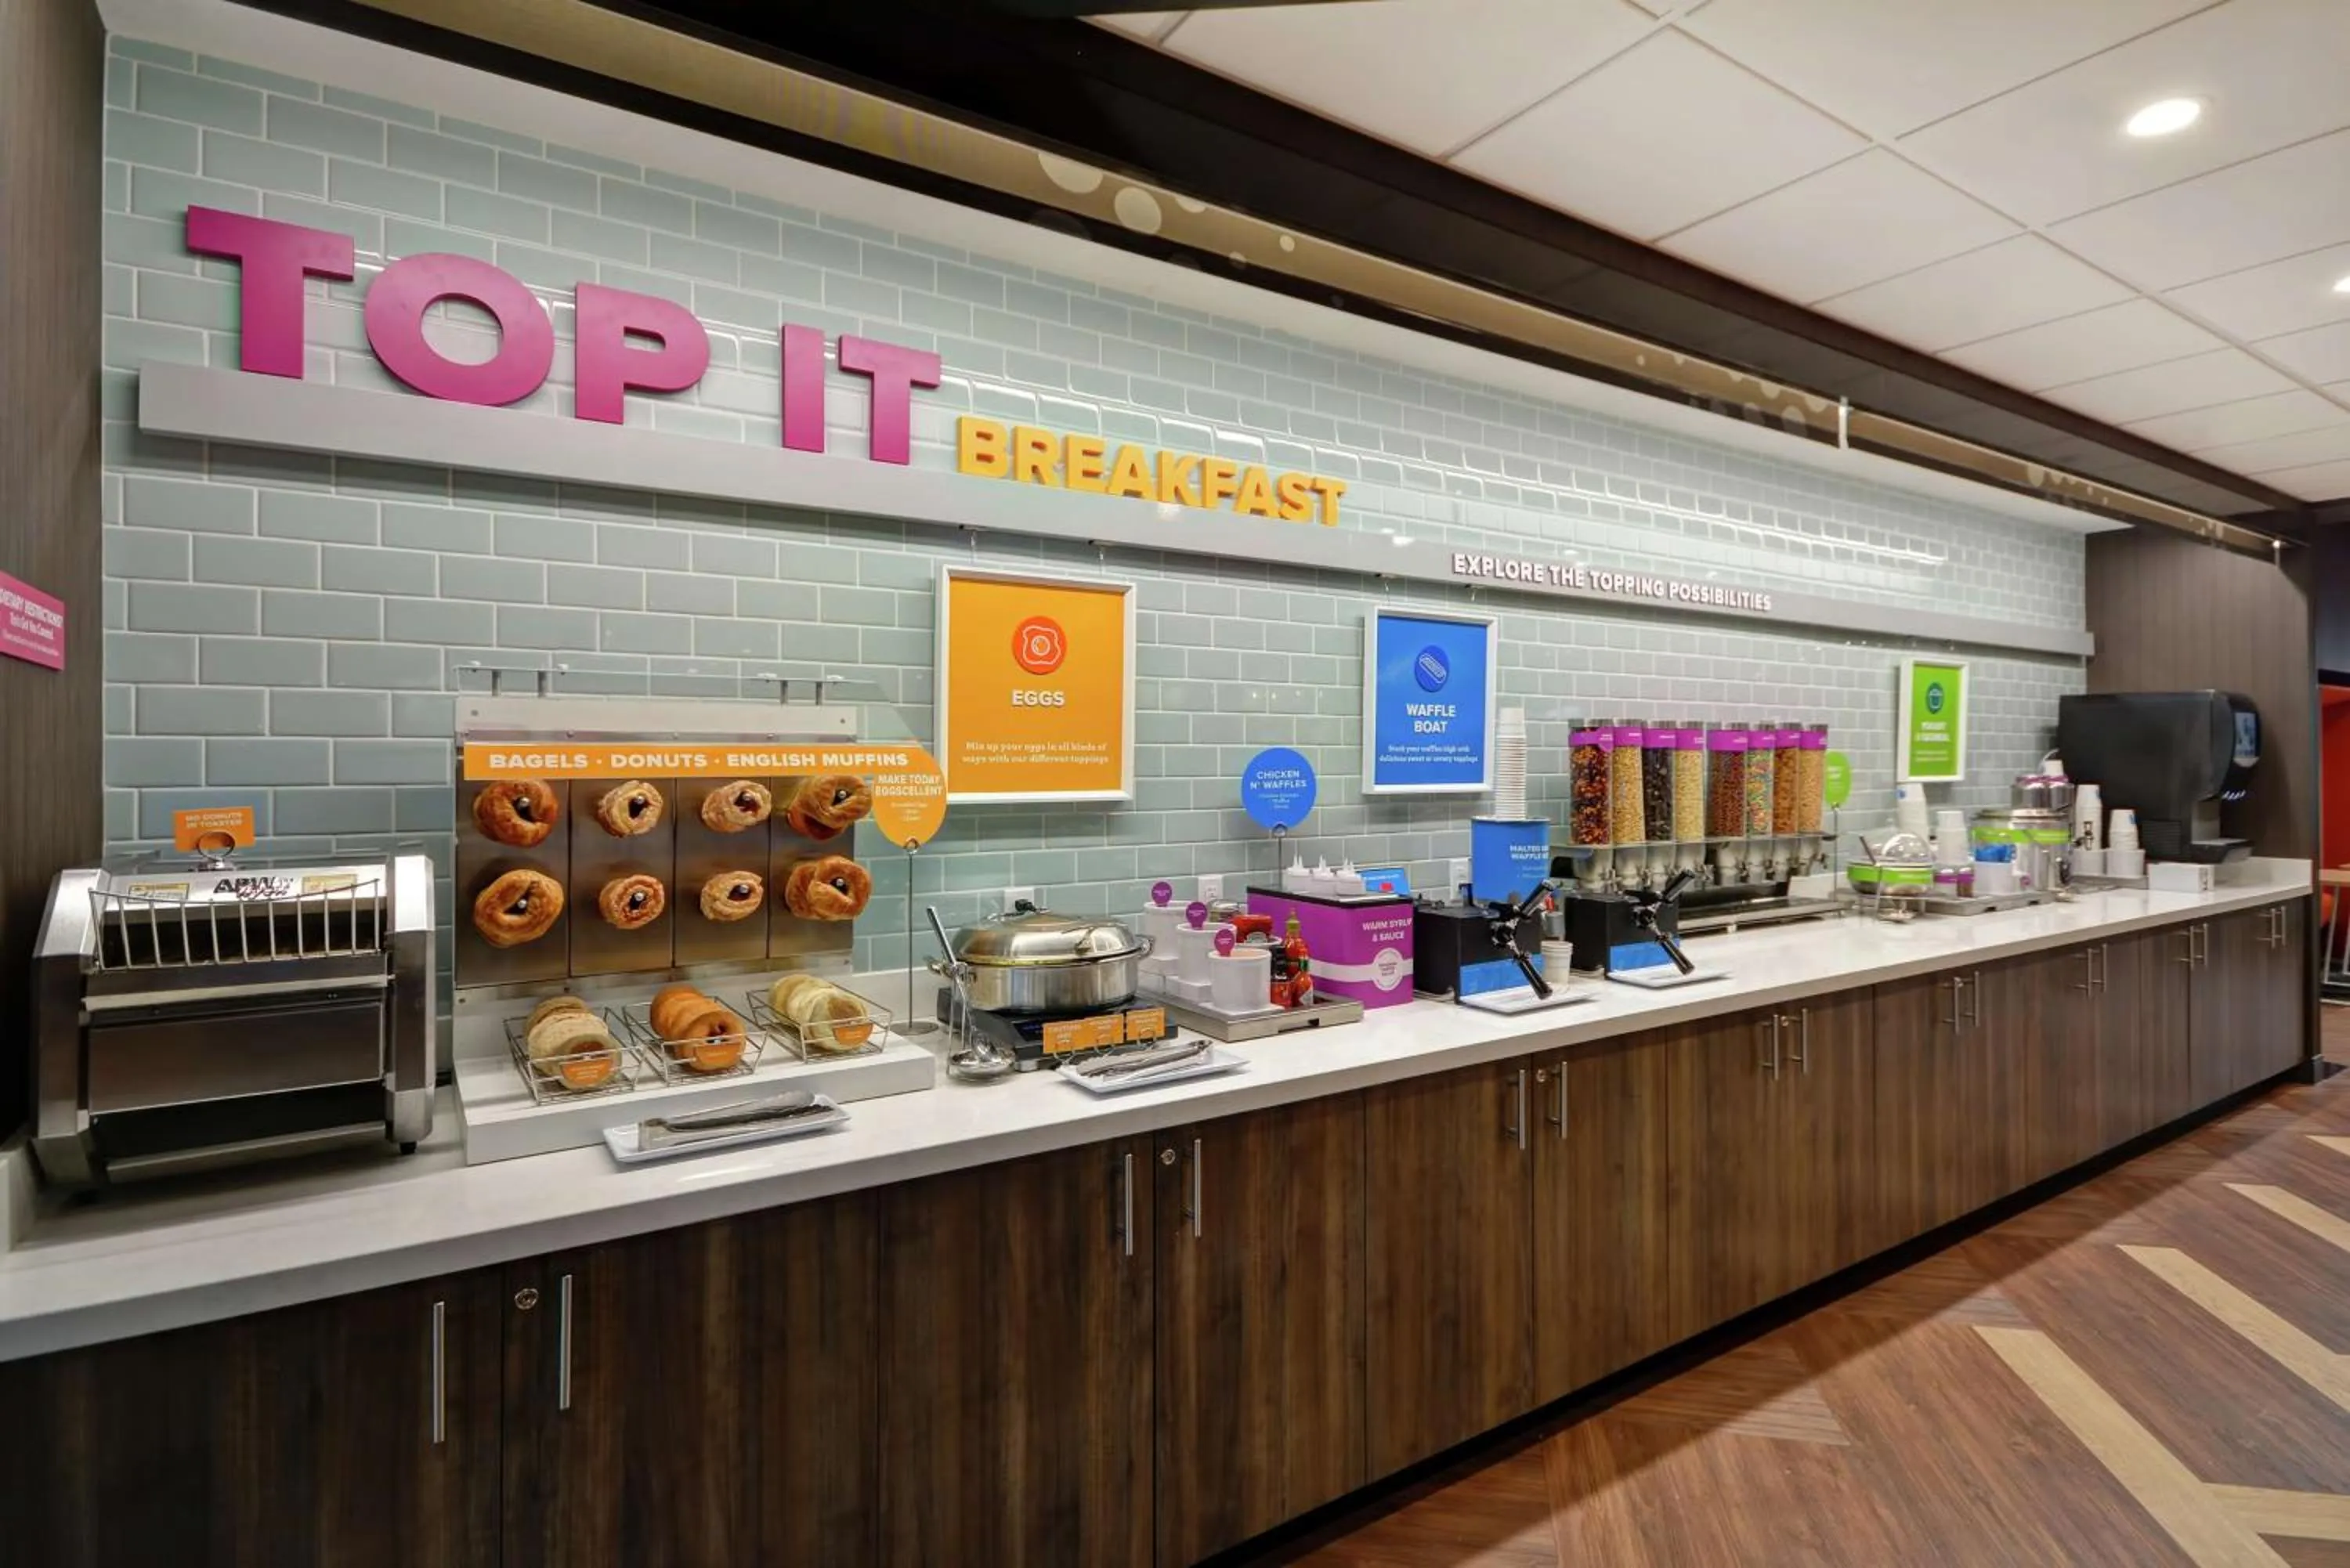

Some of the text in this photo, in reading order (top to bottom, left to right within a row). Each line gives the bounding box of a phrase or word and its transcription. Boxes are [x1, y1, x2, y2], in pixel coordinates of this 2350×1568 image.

[185, 204, 942, 465] TOP IT
[956, 414, 1347, 527] BREAKFAST
[1452, 553, 1772, 612] EXPLORE THE TOPPING POSSIBILITIES
[1011, 689, 1065, 706] EGGS
[1406, 703, 1456, 717] WAFFLE
[1414, 720, 1448, 733] BOAT
[1000, 743, 1022, 752] your
[1024, 743, 1046, 753] eggs
[488, 753, 909, 769] BAGELS DONUTS ENGLISH MUFFINS
[988, 754, 1010, 763] with
[877, 774, 941, 784] MAKE TODAY
[1256, 770, 1300, 780] CHICKEN
[1262, 779, 1308, 789] WAFFLES
[874, 785, 944, 797] EGGSCELLENT
[1362, 920, 1388, 931] WARM
